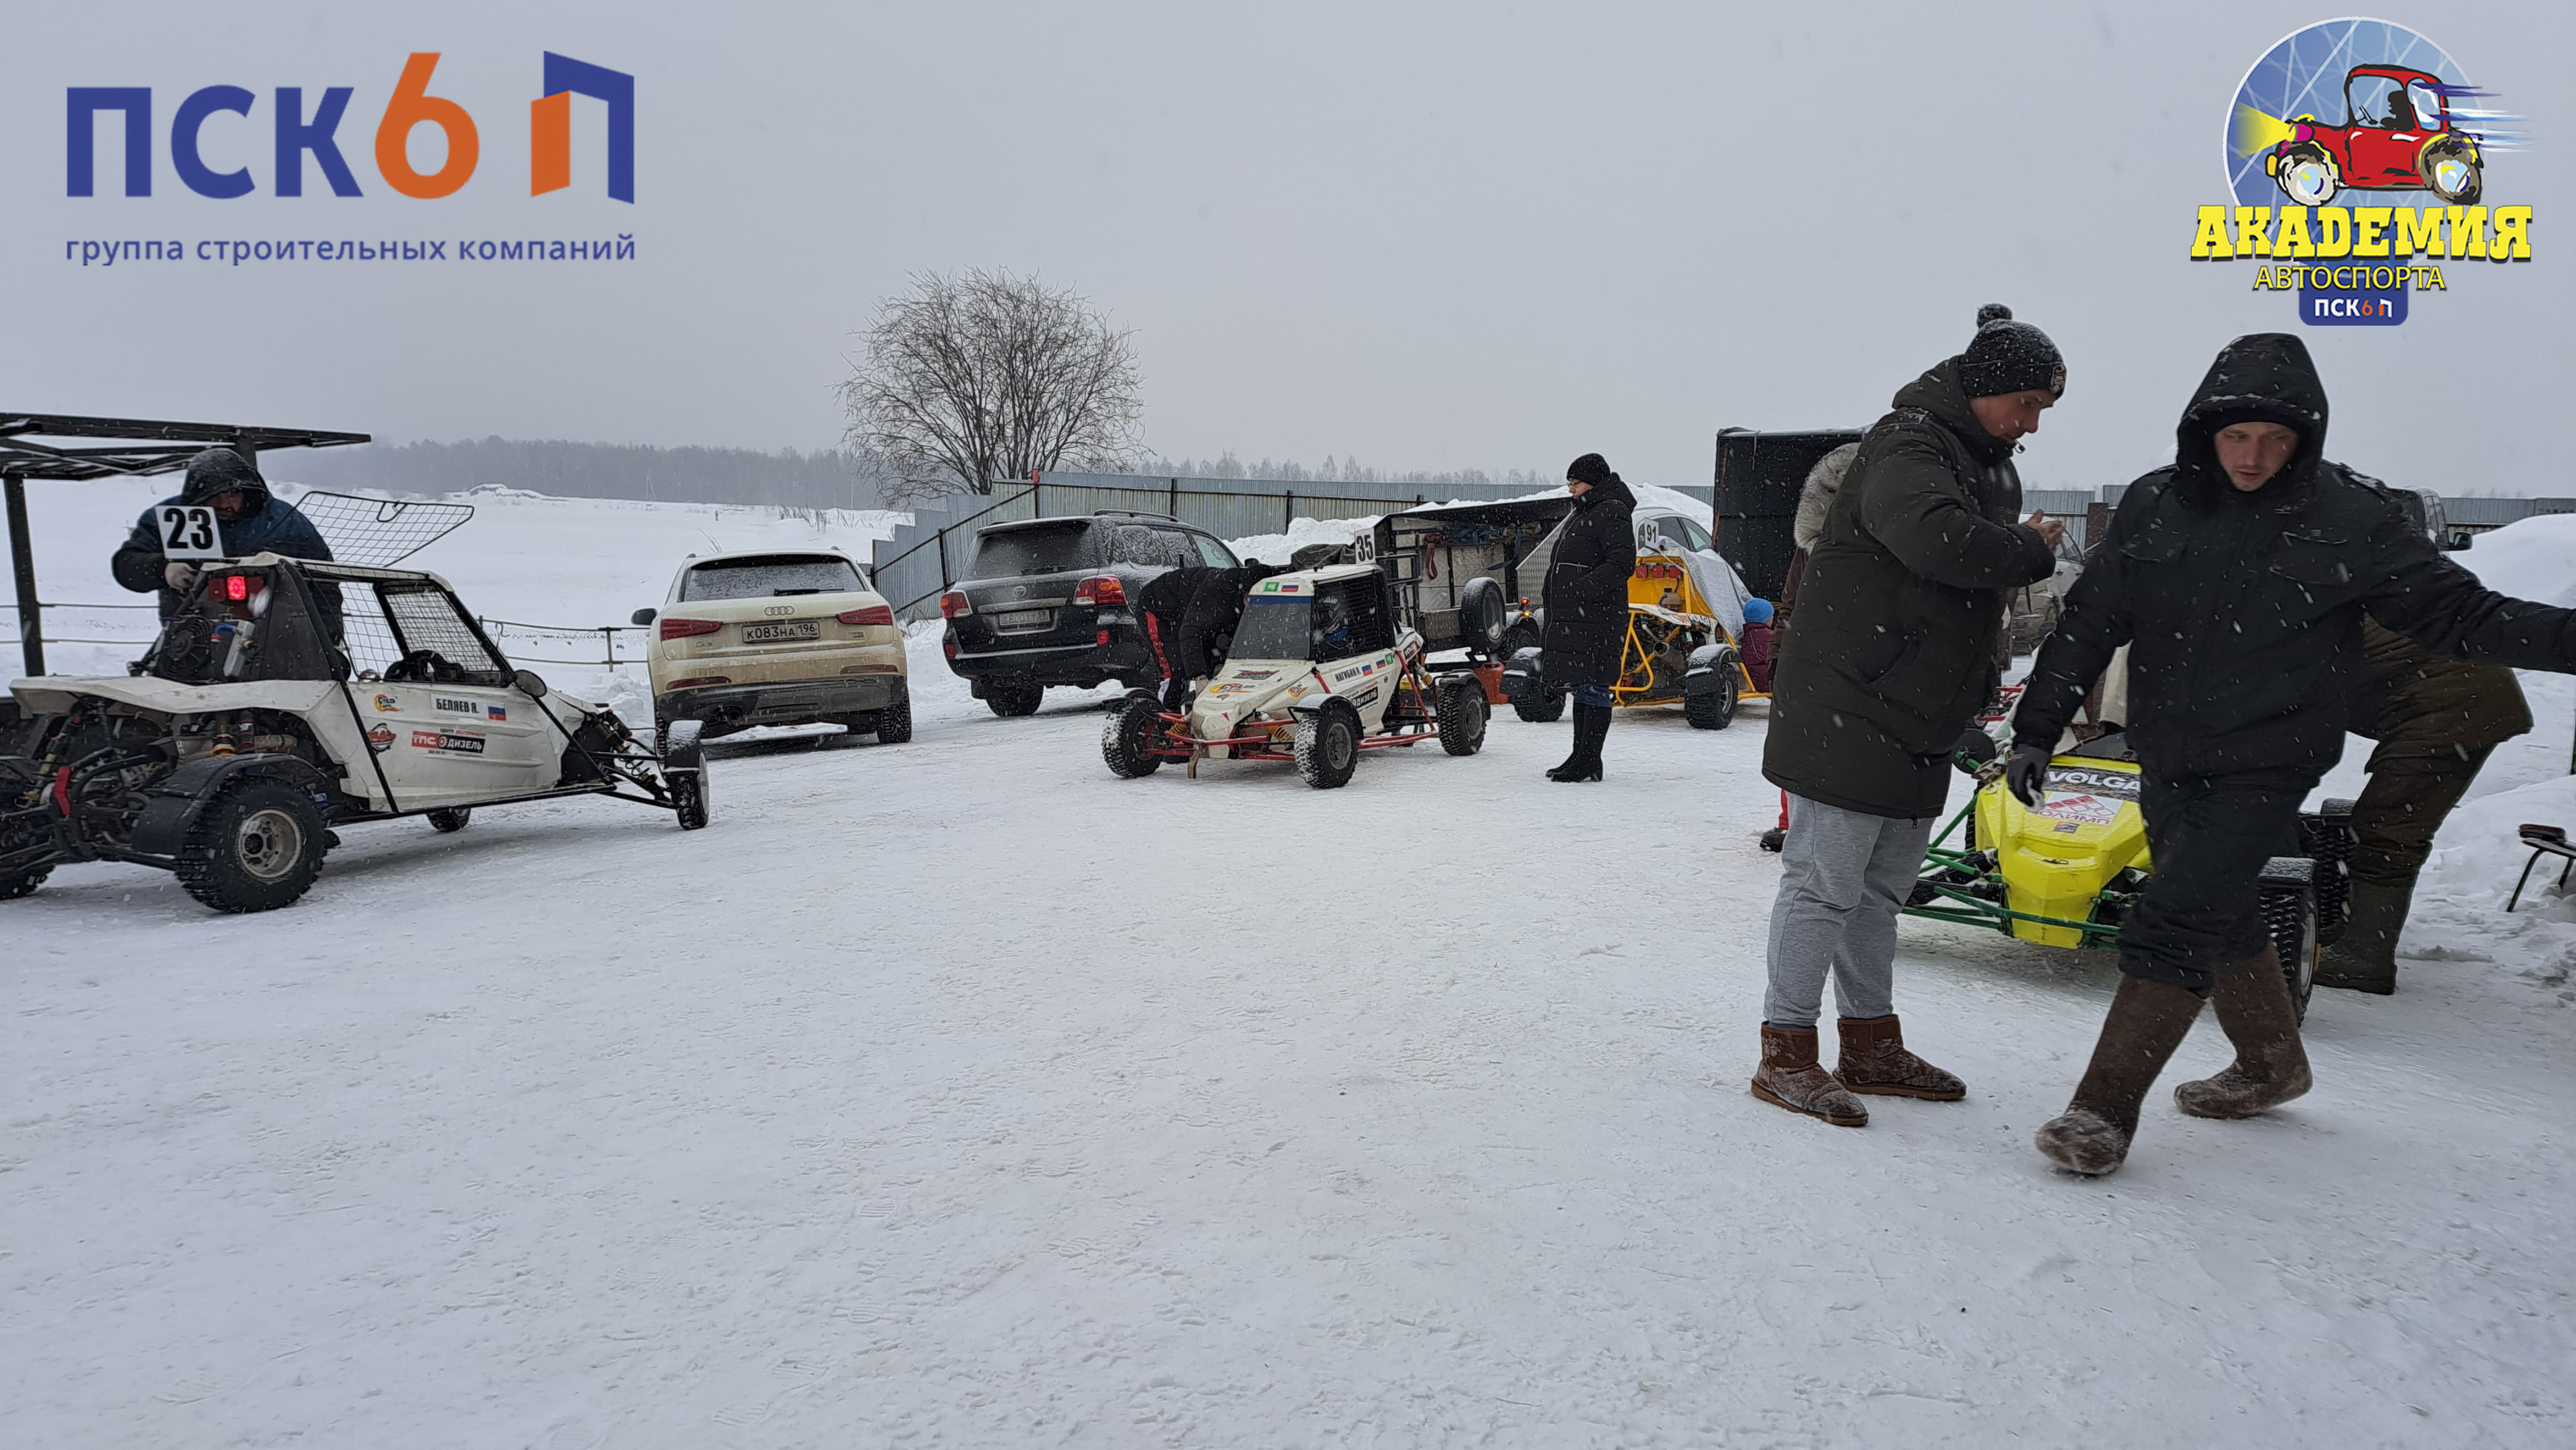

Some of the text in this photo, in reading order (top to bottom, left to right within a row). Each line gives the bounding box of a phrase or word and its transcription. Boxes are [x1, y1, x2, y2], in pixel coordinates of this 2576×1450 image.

[163, 508, 214, 550] 23
[1647, 524, 1656, 544] 91
[1357, 534, 1374, 562] 35
[747, 623, 815, 639] К083НА 196
[436, 698, 479, 713] БЕЛЯЕВ Я.
[1357, 688, 1377, 707] ДИЗЕЛЬ
[447, 739, 482, 750] ДИЗЕЛЬ
[2048, 771, 2141, 792] VOLGA
[2039, 810, 2110, 825] ОЛИМП
